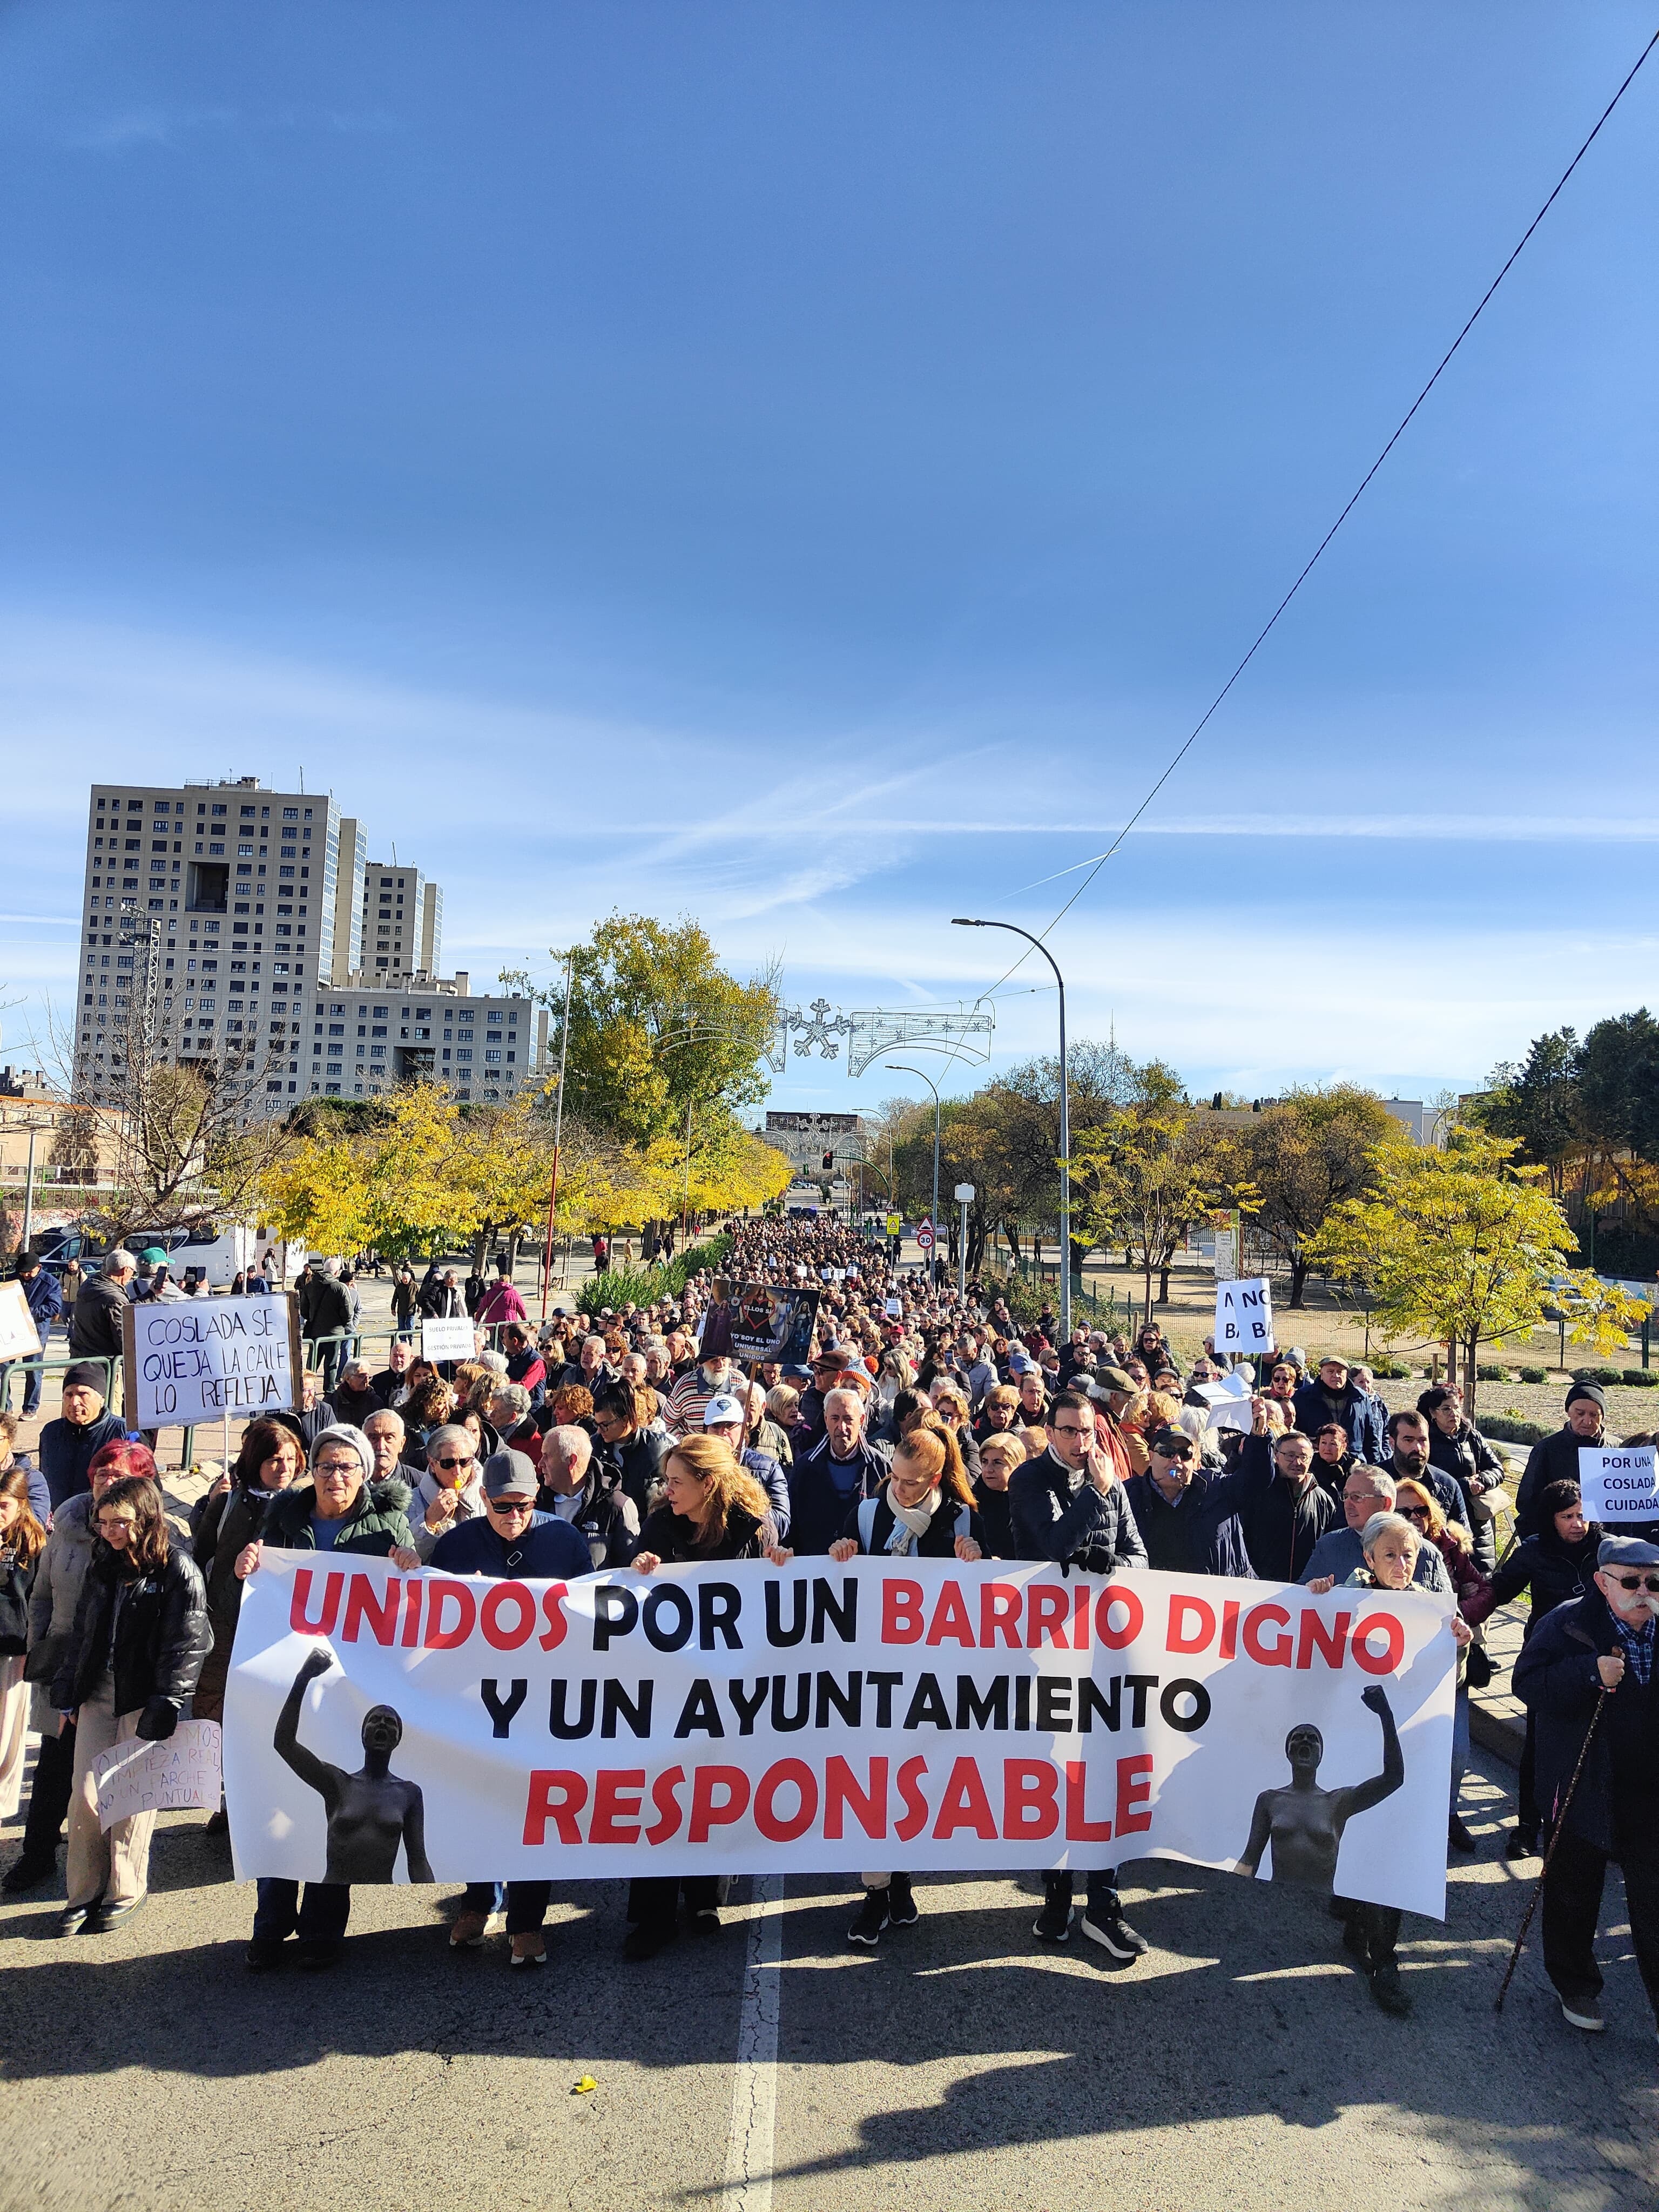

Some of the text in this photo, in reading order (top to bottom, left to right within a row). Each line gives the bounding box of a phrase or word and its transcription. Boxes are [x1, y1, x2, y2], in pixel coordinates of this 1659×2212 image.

[1242, 1289, 1270, 1308] NO
[744, 1305, 764, 1313] ELLOS
[148, 1309, 273, 1345] COSLADA SE
[734, 1341, 772, 1353] UNIVERSAL
[740, 1334, 755, 1342] SOY
[144, 1342, 286, 1381] QUEJA LA CALLE
[739, 1352, 765, 1361] UNIDOS
[156, 1374, 281, 1415] LO REFLEJA
[1602, 1455, 1652, 1468] POR UNA
[1603, 1477, 1656, 1489] COSLADA
[1605, 1498, 1659, 1510] CUIDADA
[289, 1568, 1405, 1675] UNIDOS POR UN BARRIO DIGNO
[480, 1670, 1211, 1740] Y UN AYUNTAMIENTO
[99, 1771, 206, 1813] NO UN PARCHE
[522, 1755, 1153, 1846] RESPONSABLE
